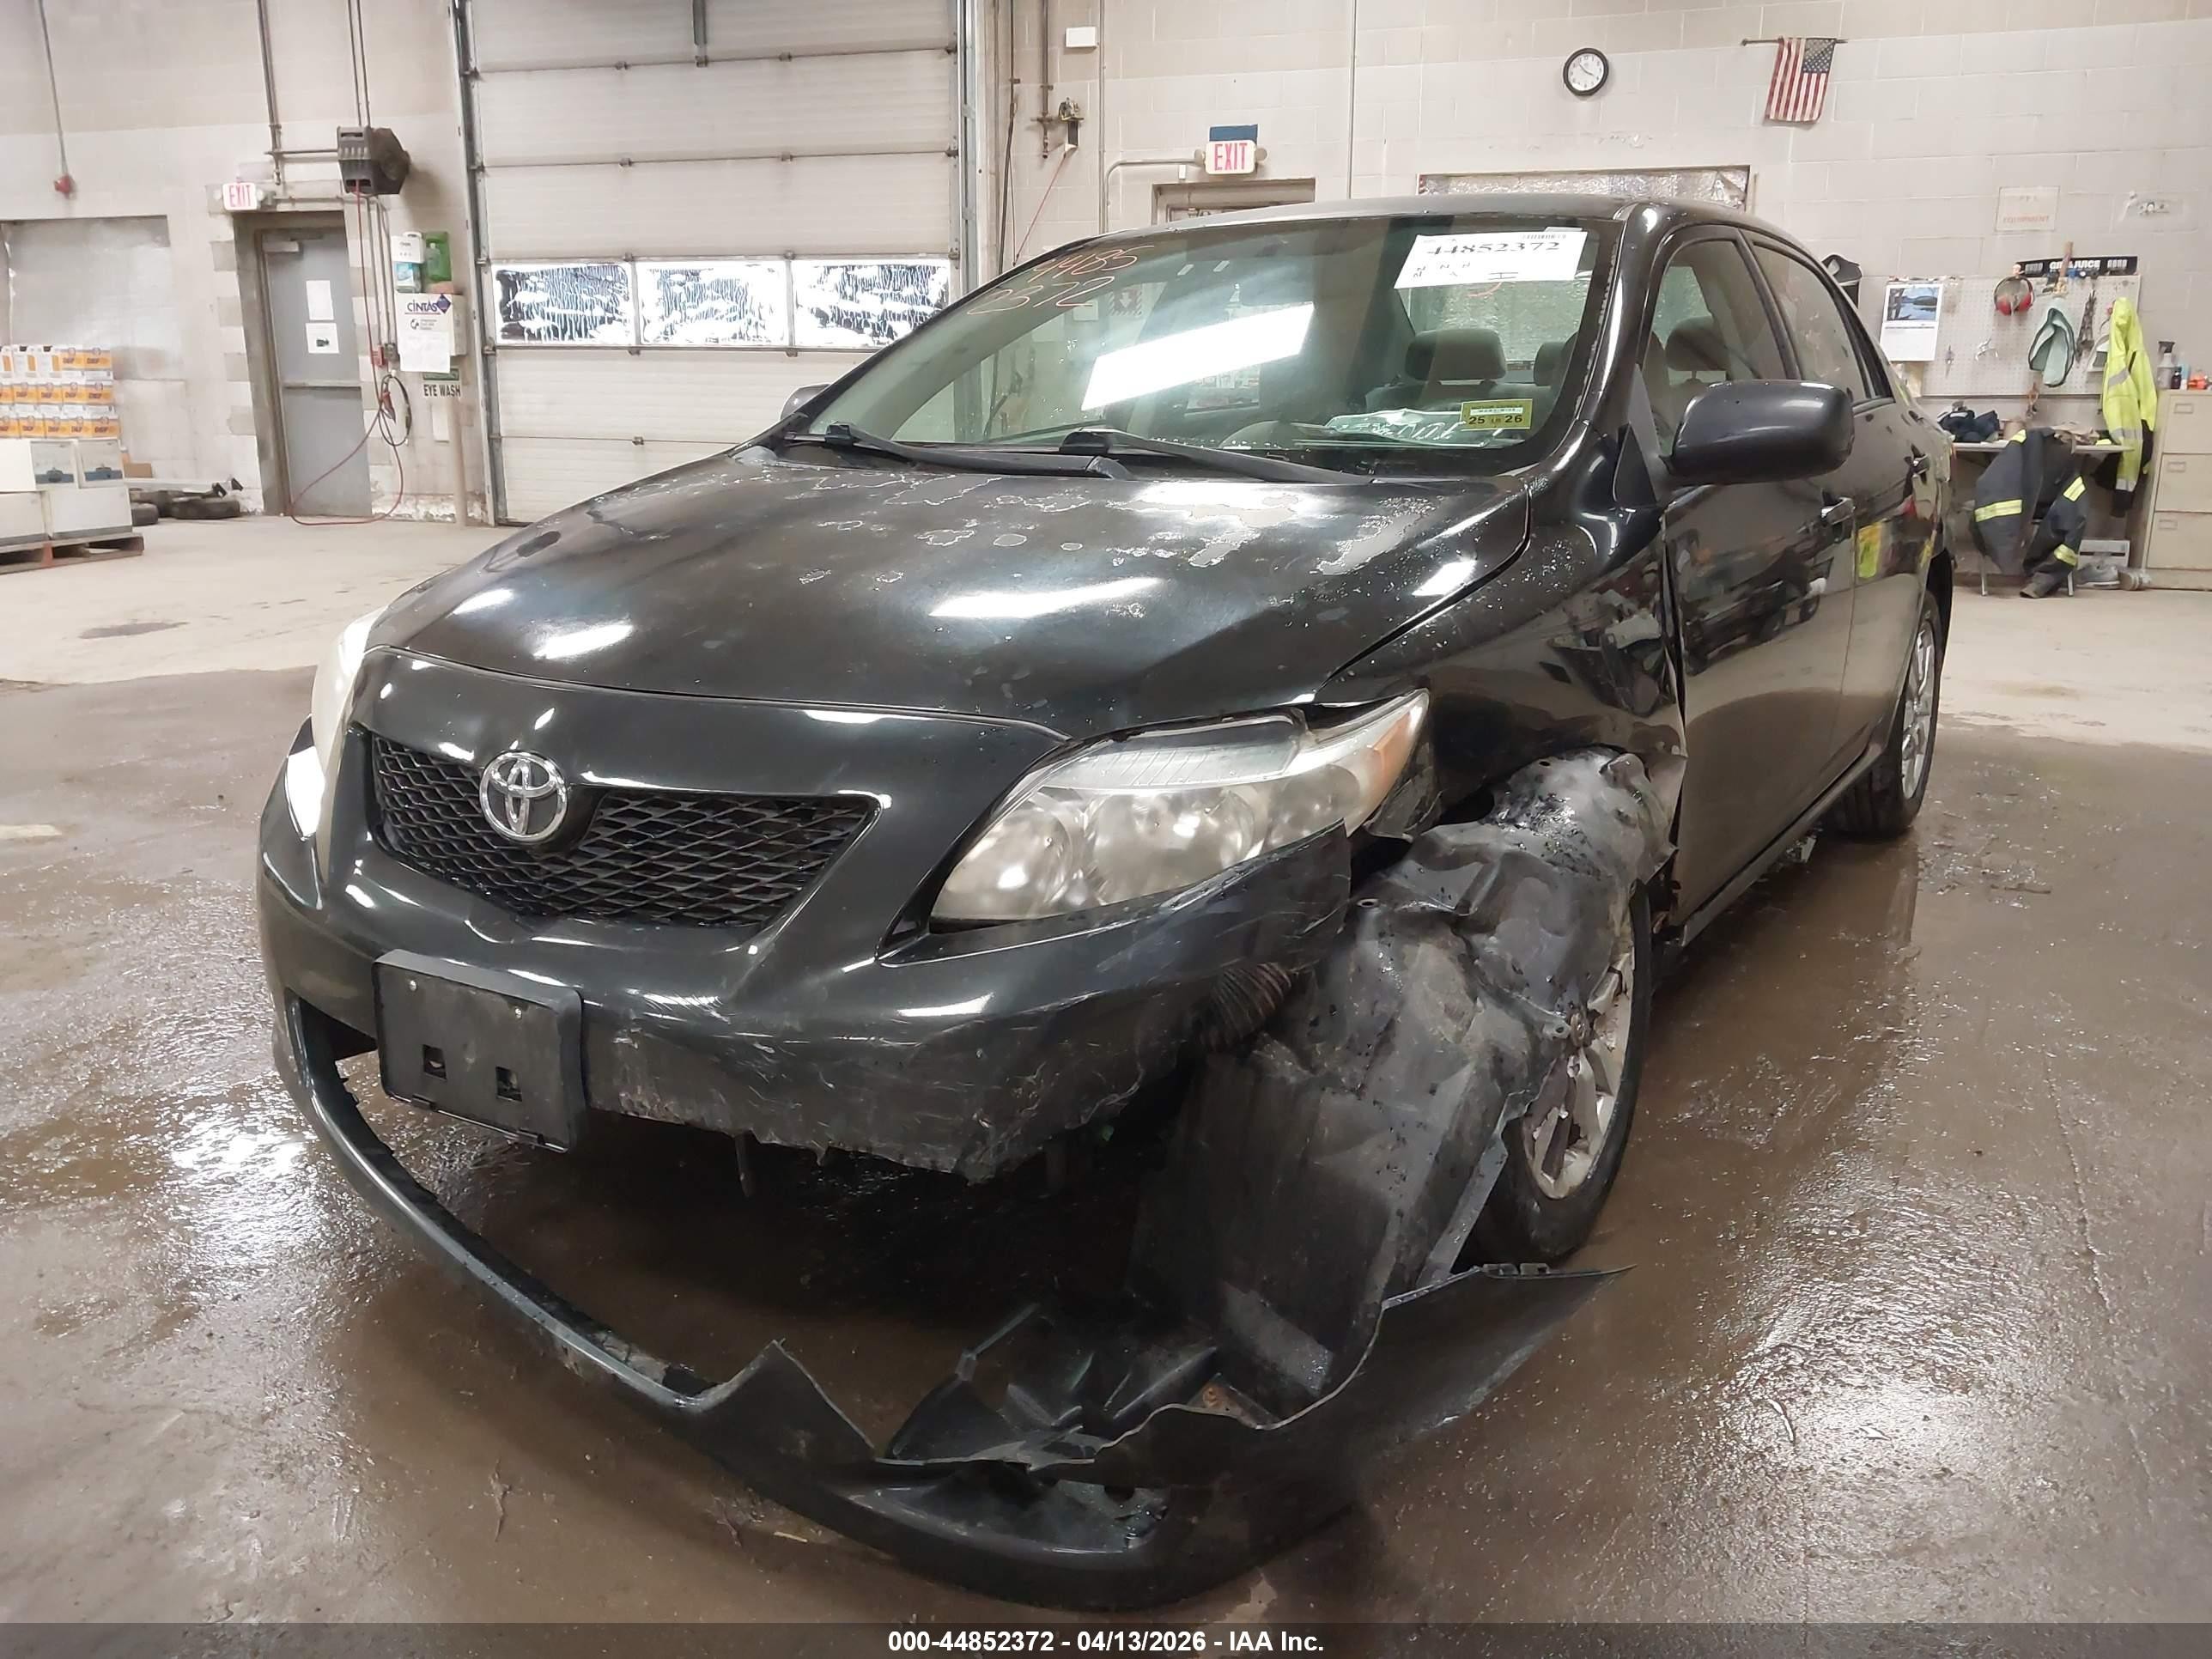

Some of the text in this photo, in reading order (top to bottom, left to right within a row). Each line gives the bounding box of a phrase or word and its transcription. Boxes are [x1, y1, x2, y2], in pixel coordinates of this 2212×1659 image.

[1214, 143, 1248, 171] EXIT
[228, 185, 251, 207] EXIT
[1427, 241, 1560, 255] 44852372
[2074, 259, 2101, 269] JUICE
[407, 300, 438, 313] CINTAS
[423, 384, 461, 397] EYE WASH
[1468, 416, 1486, 425] 25
[1504, 414, 1523, 423] 26
